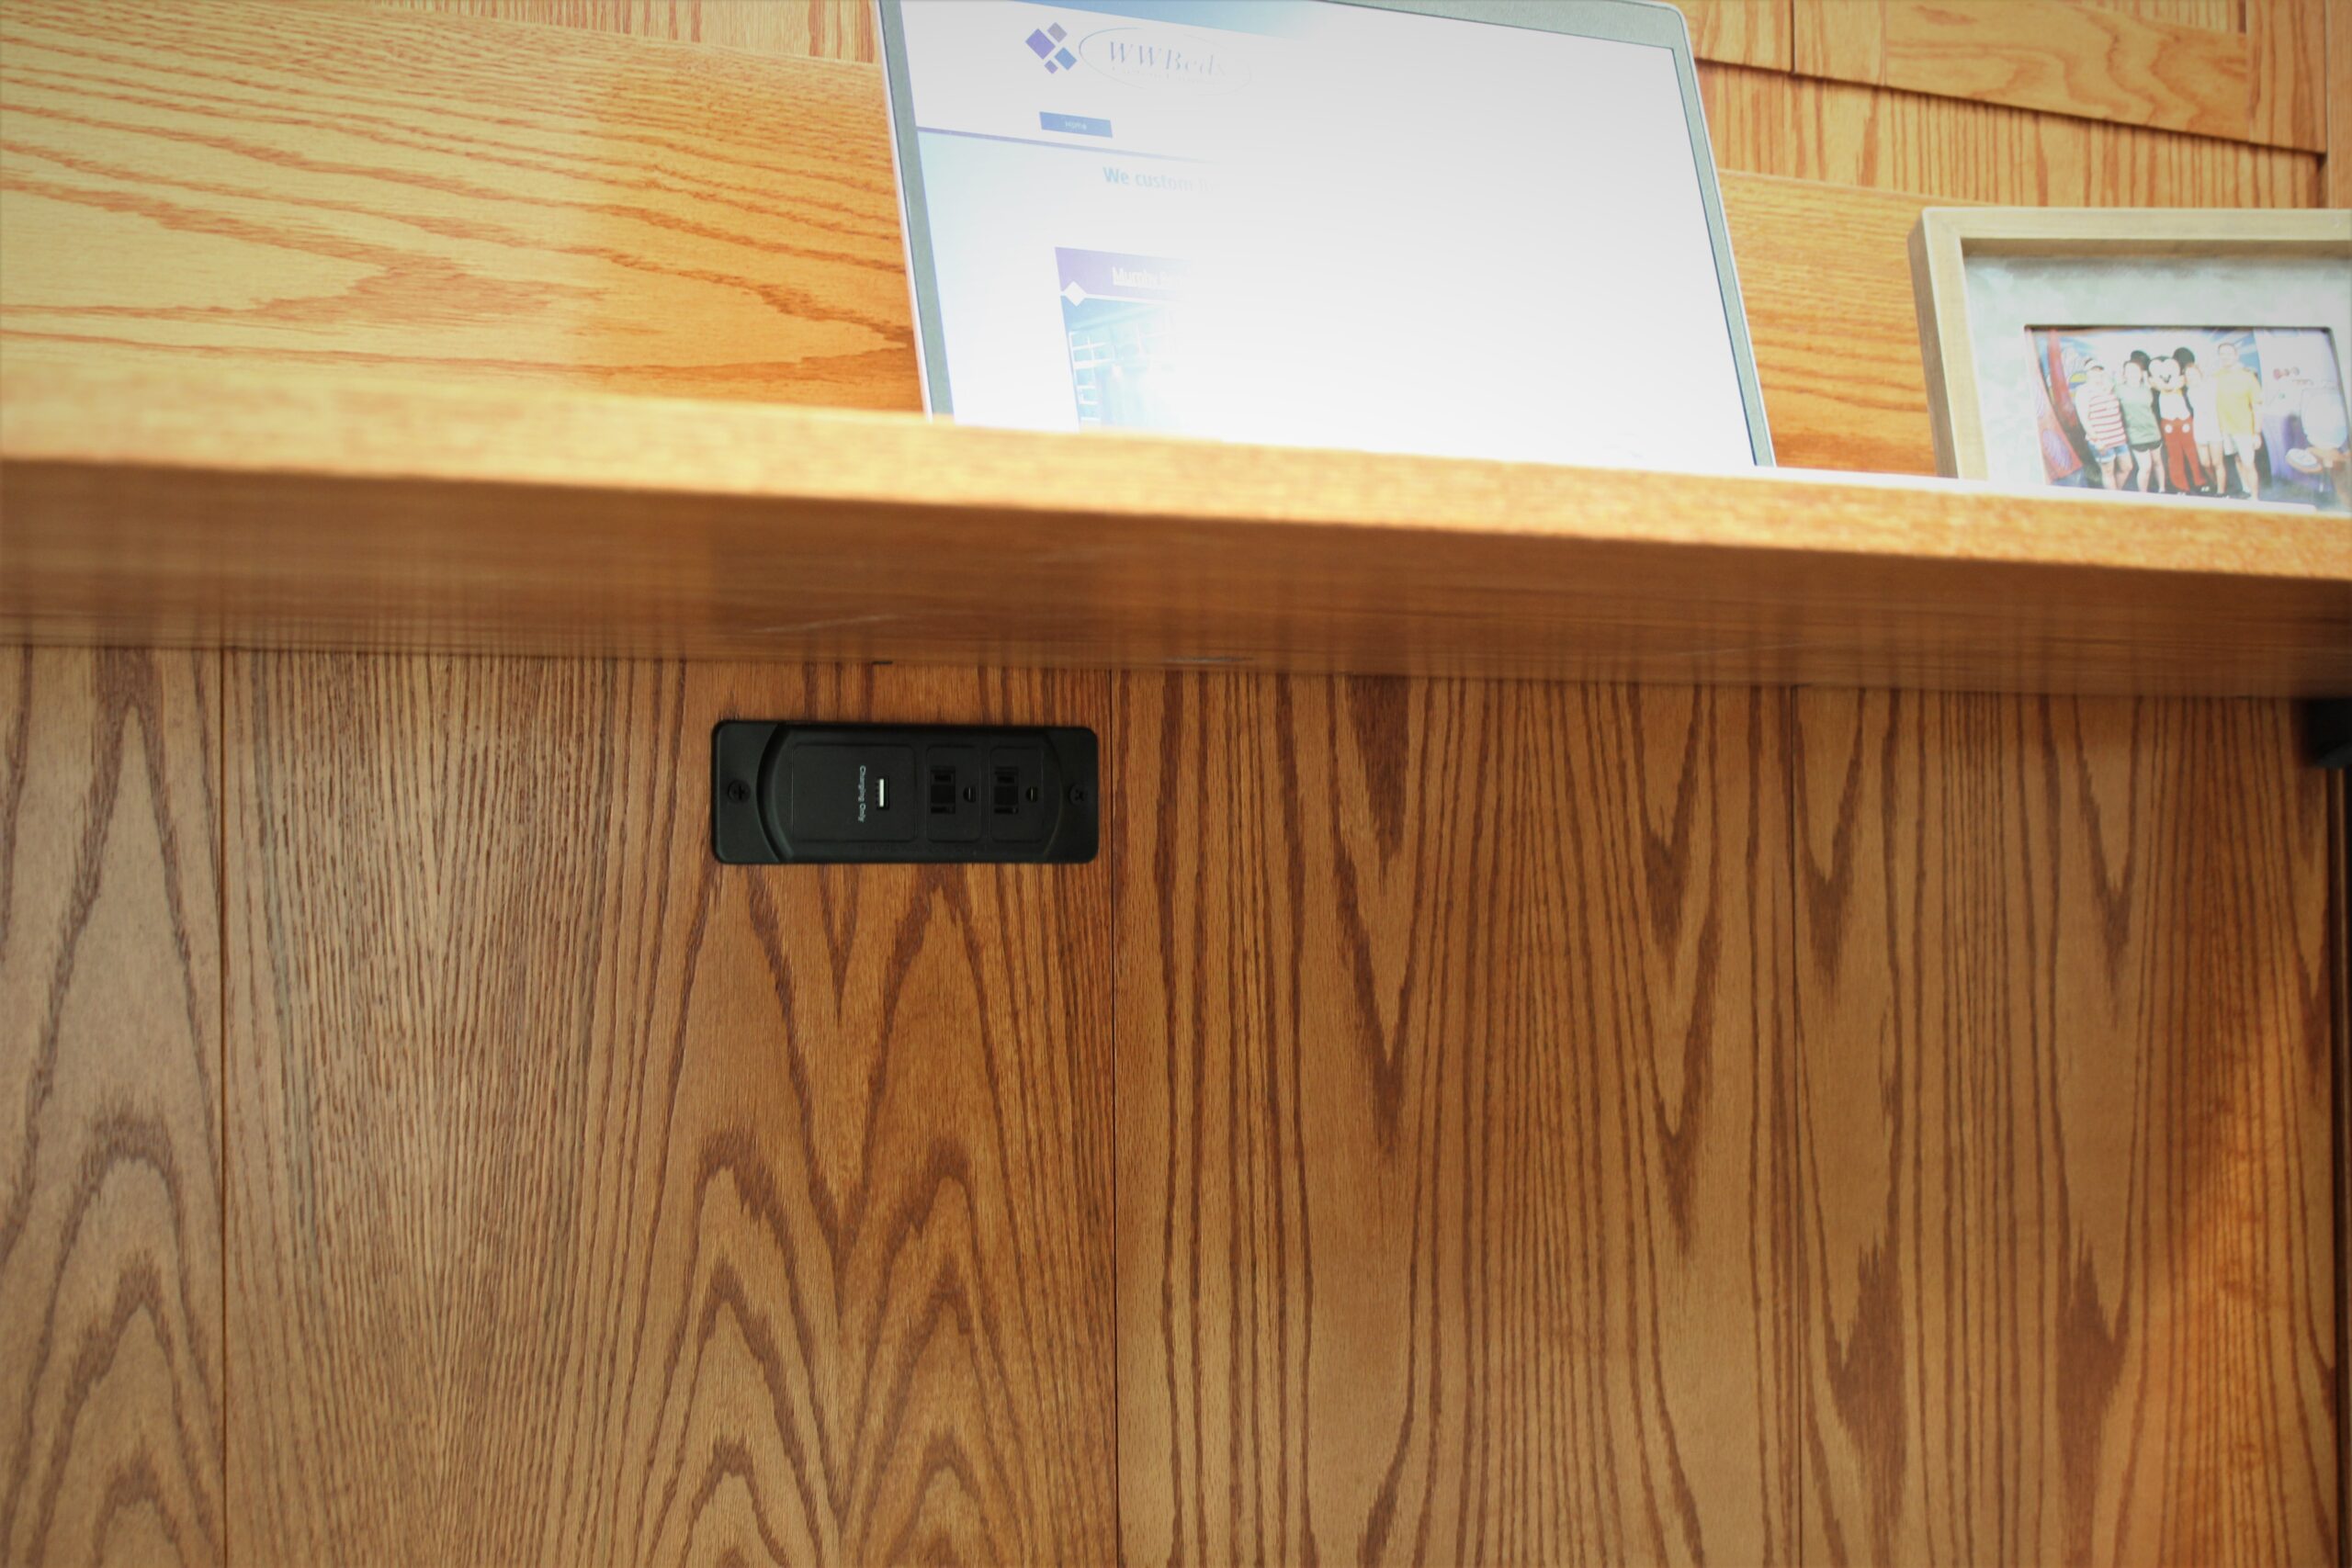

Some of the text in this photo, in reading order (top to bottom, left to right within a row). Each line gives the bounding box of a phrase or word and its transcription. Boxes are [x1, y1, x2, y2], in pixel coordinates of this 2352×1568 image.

[1110, 41, 1226, 76] WWBeds
[1102, 166, 1130, 185] We
[1135, 173, 1193, 192] custom
[858, 765, 866, 823] Charging Only
